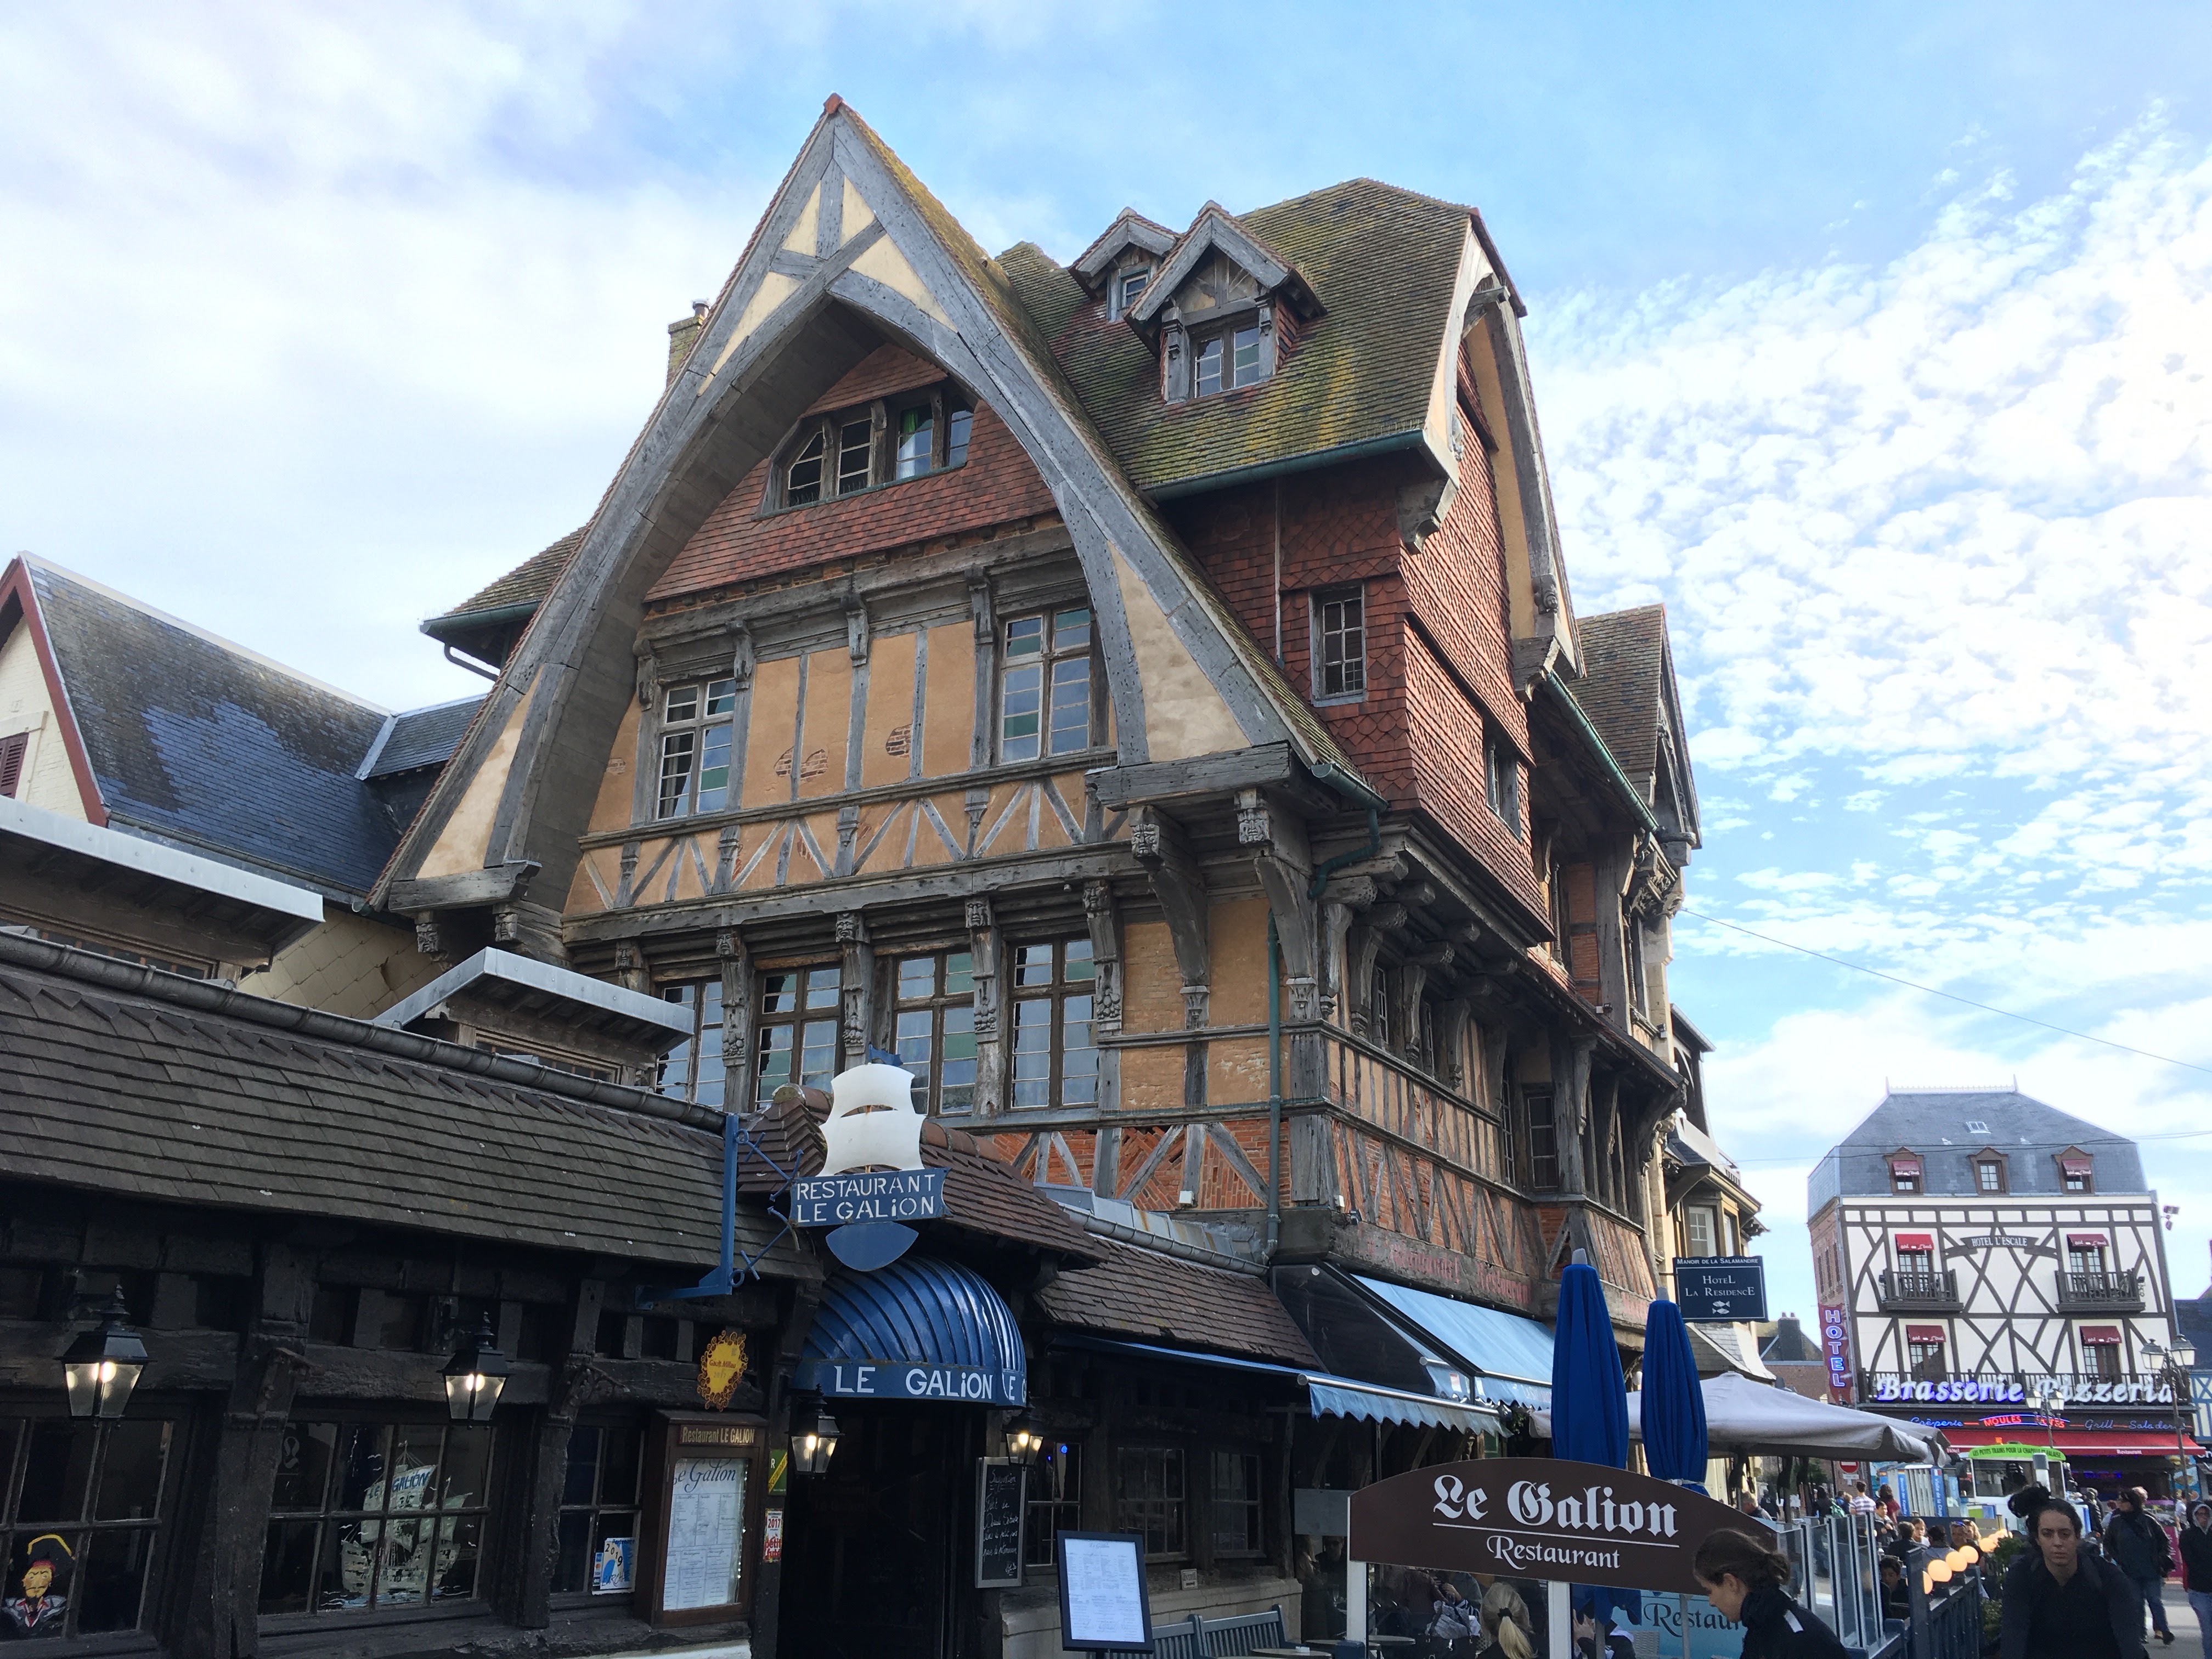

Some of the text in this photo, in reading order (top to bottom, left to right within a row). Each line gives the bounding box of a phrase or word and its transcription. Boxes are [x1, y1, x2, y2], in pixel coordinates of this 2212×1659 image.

[797, 1173, 936, 1200] RESTAURANT
[797, 1203, 827, 1223] LE
[1972, 1236, 2028, 1247] HOTEL L'ESCALE
[1703, 1275, 1736, 1284] HOTEL
[1705, 1287, 1755, 1296] RESIDENCE
[1824, 1308, 1846, 1388] HOTEL
[834, 1366, 875, 1393] LE
[1002, 1373, 1016, 1401] LE
[1876, 1374, 2174, 1403] Brasserie Pizzeria
[1983, 1415, 2022, 1427] MOULES
[2085, 1419, 2114, 1430] Grill
[2128, 1420, 2185, 1430] Salader
[682, 1426, 755, 1443] Restaurant LE GALION
[673, 1470, 686, 1485] e
[1432, 1474, 1679, 1539] Le Galion
[768, 1519, 781, 1528] 2017
[1487, 1534, 1621, 1570] Restaurant
